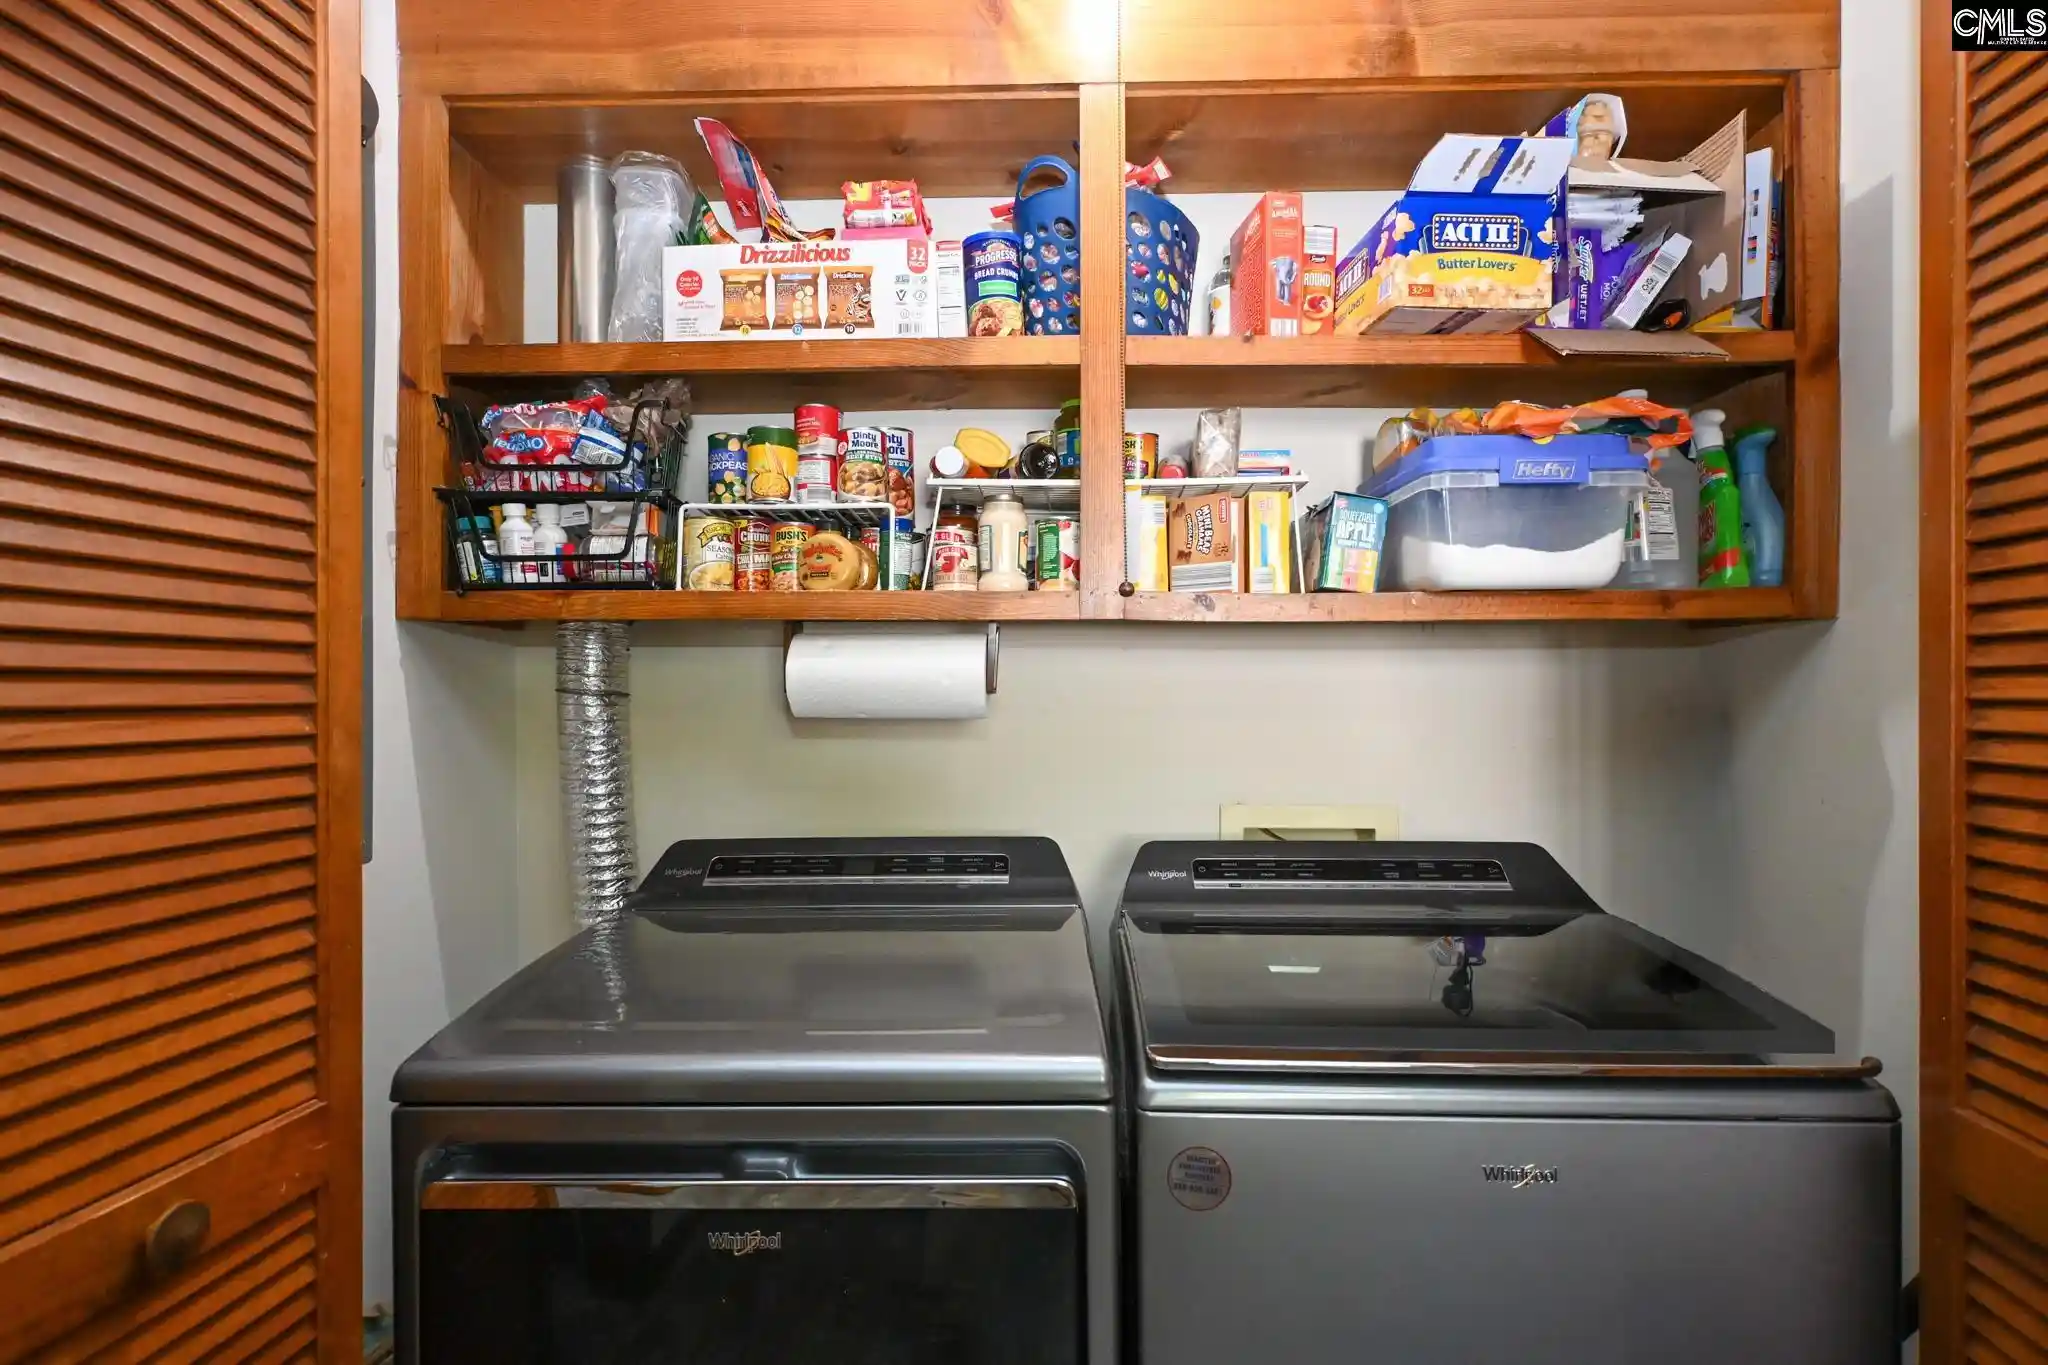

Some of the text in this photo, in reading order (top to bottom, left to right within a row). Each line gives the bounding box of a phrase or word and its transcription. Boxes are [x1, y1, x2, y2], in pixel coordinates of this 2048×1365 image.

[1441, 222, 1511, 243] ACT II
[740, 242, 851, 264] Drizzilicious
[910, 247, 926, 261] 32
[1437, 257, 1476, 270] Butter
[974, 269, 995, 280] BREAD
[1303, 272, 1331, 288] ROUND
[1579, 284, 1589, 322] WETJET
[851, 440, 879, 449] Moore
[852, 431, 877, 445] Dinty
[887, 434, 903, 447] nty
[888, 446, 906, 456] ore
[711, 461, 748, 471] CKPEAS
[1516, 462, 1572, 480] Hefty
[775, 530, 807, 542] BUSH'S
[1186, 514, 1194, 549] CHOCOLATE
[1195, 508, 1205, 552] GRAHAMS
[1201, 504, 1214, 555] MINI BEAR
[1148, 869, 1187, 880] Whirlpool
[1481, 1163, 1558, 1189] Whirlpool
[707, 1230, 782, 1256] Whirlpool
